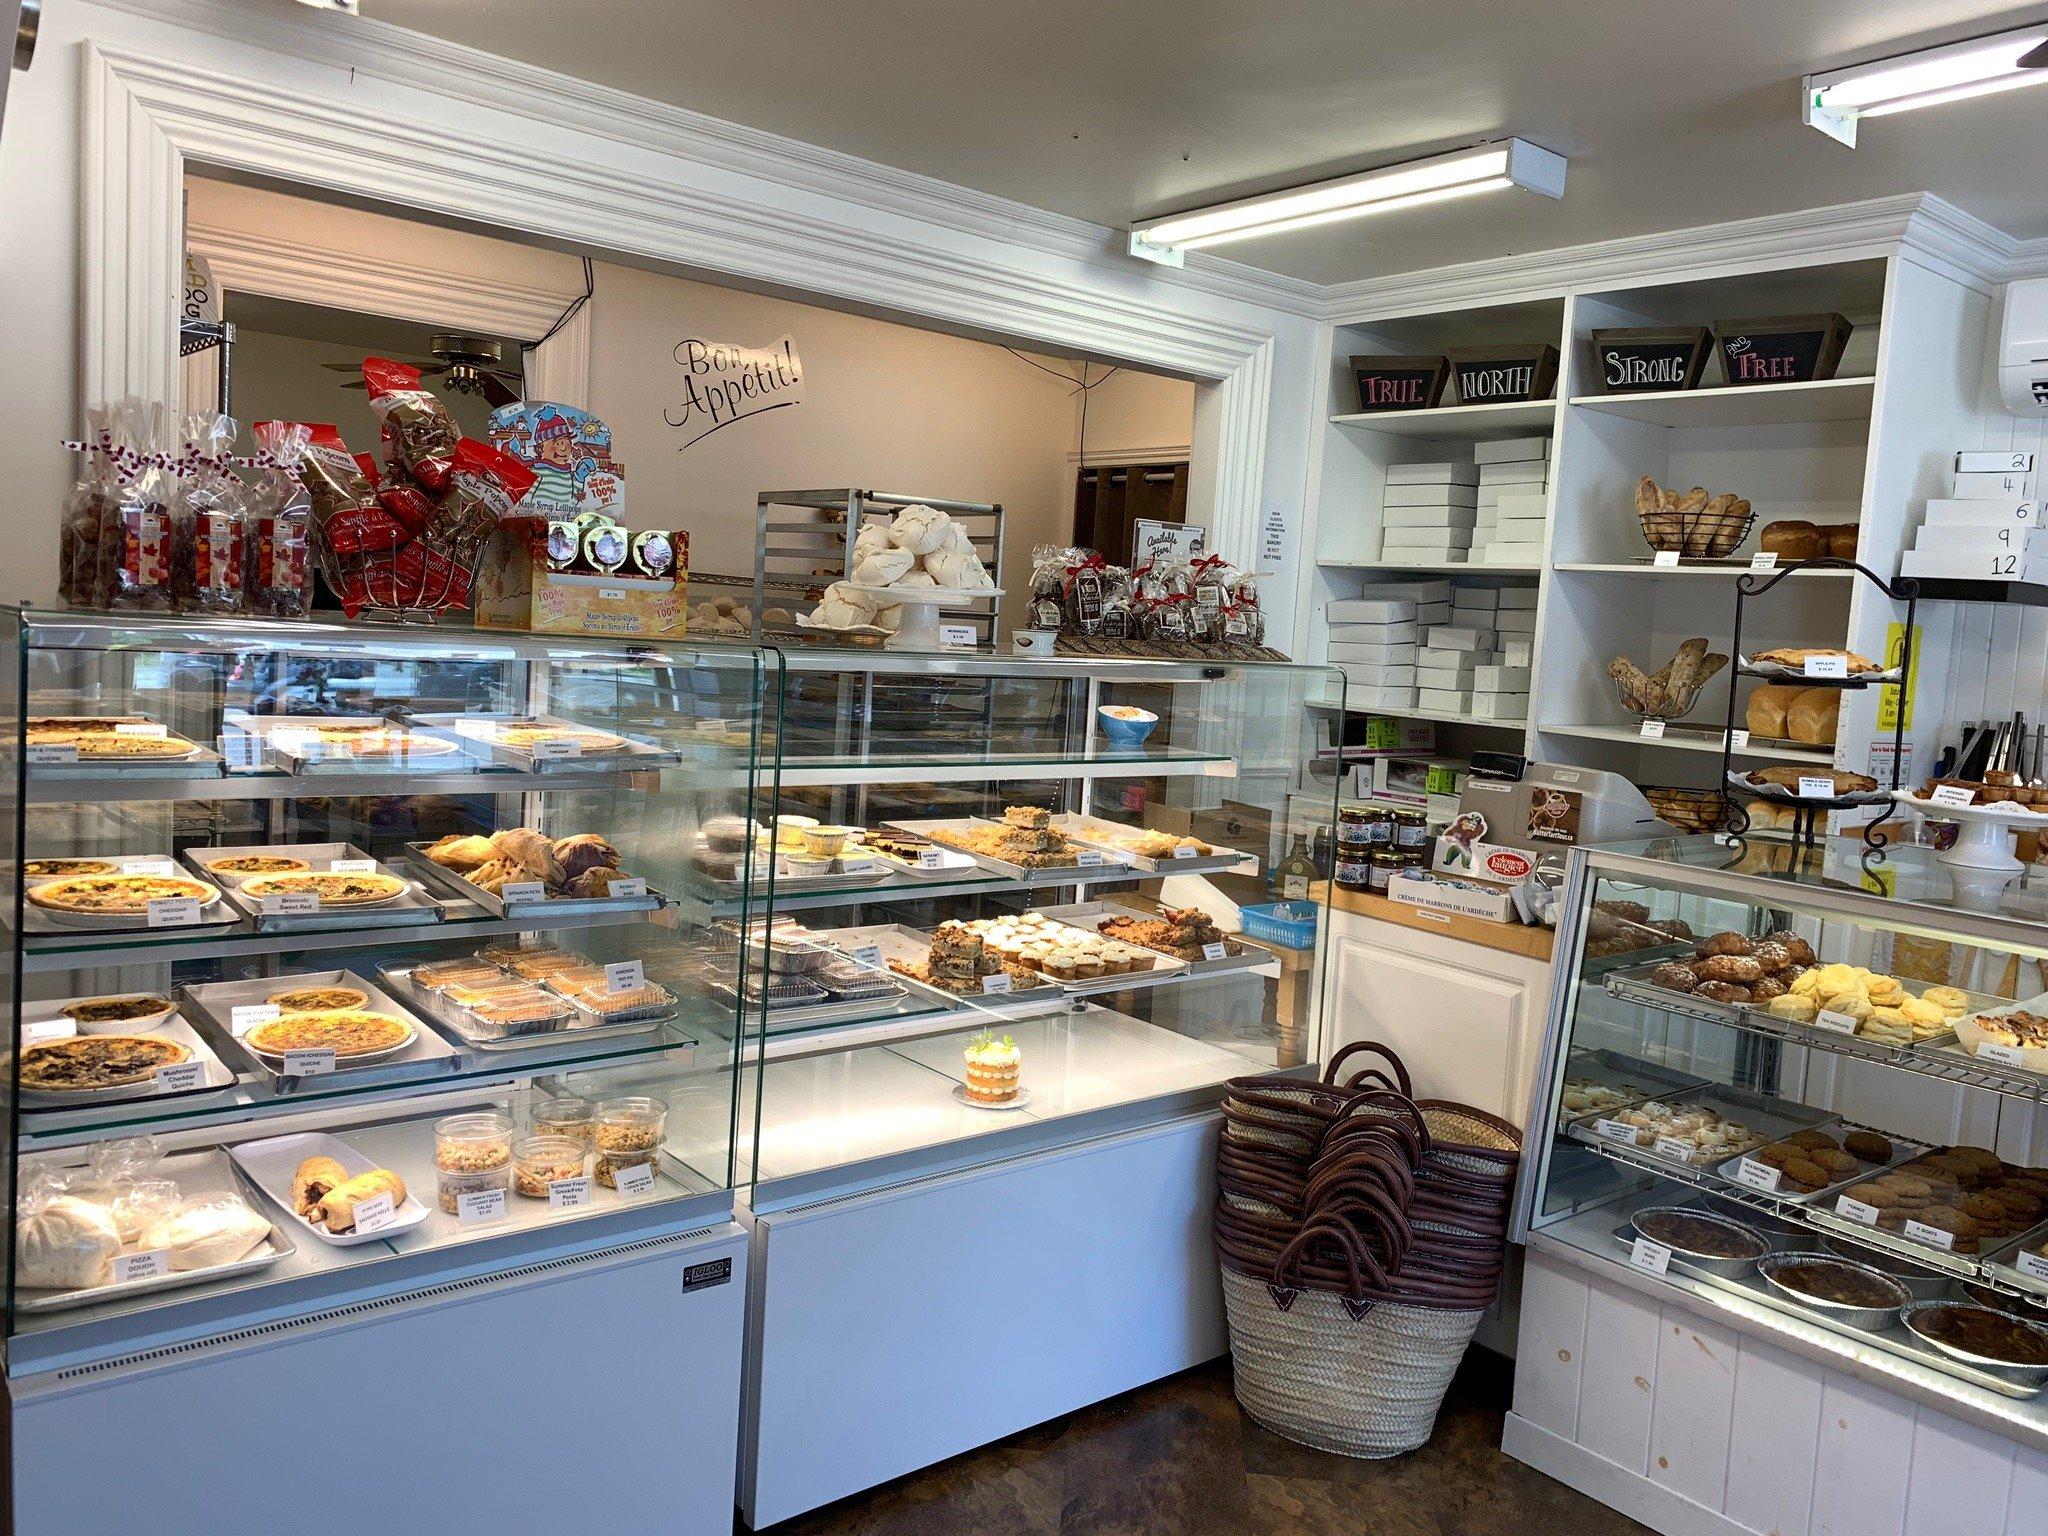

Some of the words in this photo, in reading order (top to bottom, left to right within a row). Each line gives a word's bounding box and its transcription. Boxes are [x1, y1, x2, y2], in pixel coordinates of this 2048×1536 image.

[673, 339, 743, 375] Bon
[1606, 352, 1685, 386] STRONG
[1739, 352, 1795, 380] FREE
[664, 340, 799, 427] Appétit!
[1362, 376, 1424, 404] TRUE
[1461, 366, 1534, 400] NORTH
[2012, 453, 2025, 468] 2
[2003, 477, 2014, 492] 4
[591, 485, 618, 499] 100%
[536, 499, 555, 511] Syrup
[555, 502, 582, 514] Lollipops
[2016, 502, 2030, 518] 6
[1147, 531, 1178, 548] Available
[1998, 528, 2010, 548] 9
[1150, 543, 1172, 558] Here!
[1991, 555, 2016, 575] 12
[656, 609, 681, 618] 100%
[1397, 893, 1417, 903] CRÈME
[1425, 899, 1452, 911] MARRONS
[1830, 1020, 1850, 1030] BISCUITS
[1990, 1049, 2010, 1059] GLAZED
[163, 1066, 199, 1077] Mushroom/
[168, 1074, 196, 1083] Cheddar
[171, 1082, 195, 1090] Quiche
[1664, 1145, 1681, 1154] MANGO
[1753, 1165, 1771, 1176] OATMEAL
[551, 1182, 572, 1190] Summer
[555, 1187, 583, 1196] Greek/Feta
[466, 1199, 489, 1207] TUSCANY
[1847, 1203, 1866, 1213] PEANUT
[1845, 1210, 1864, 1220] BUTTER
[130, 1255, 152, 1264] PIZZA
[128, 1263, 155, 1272] DOUGH
